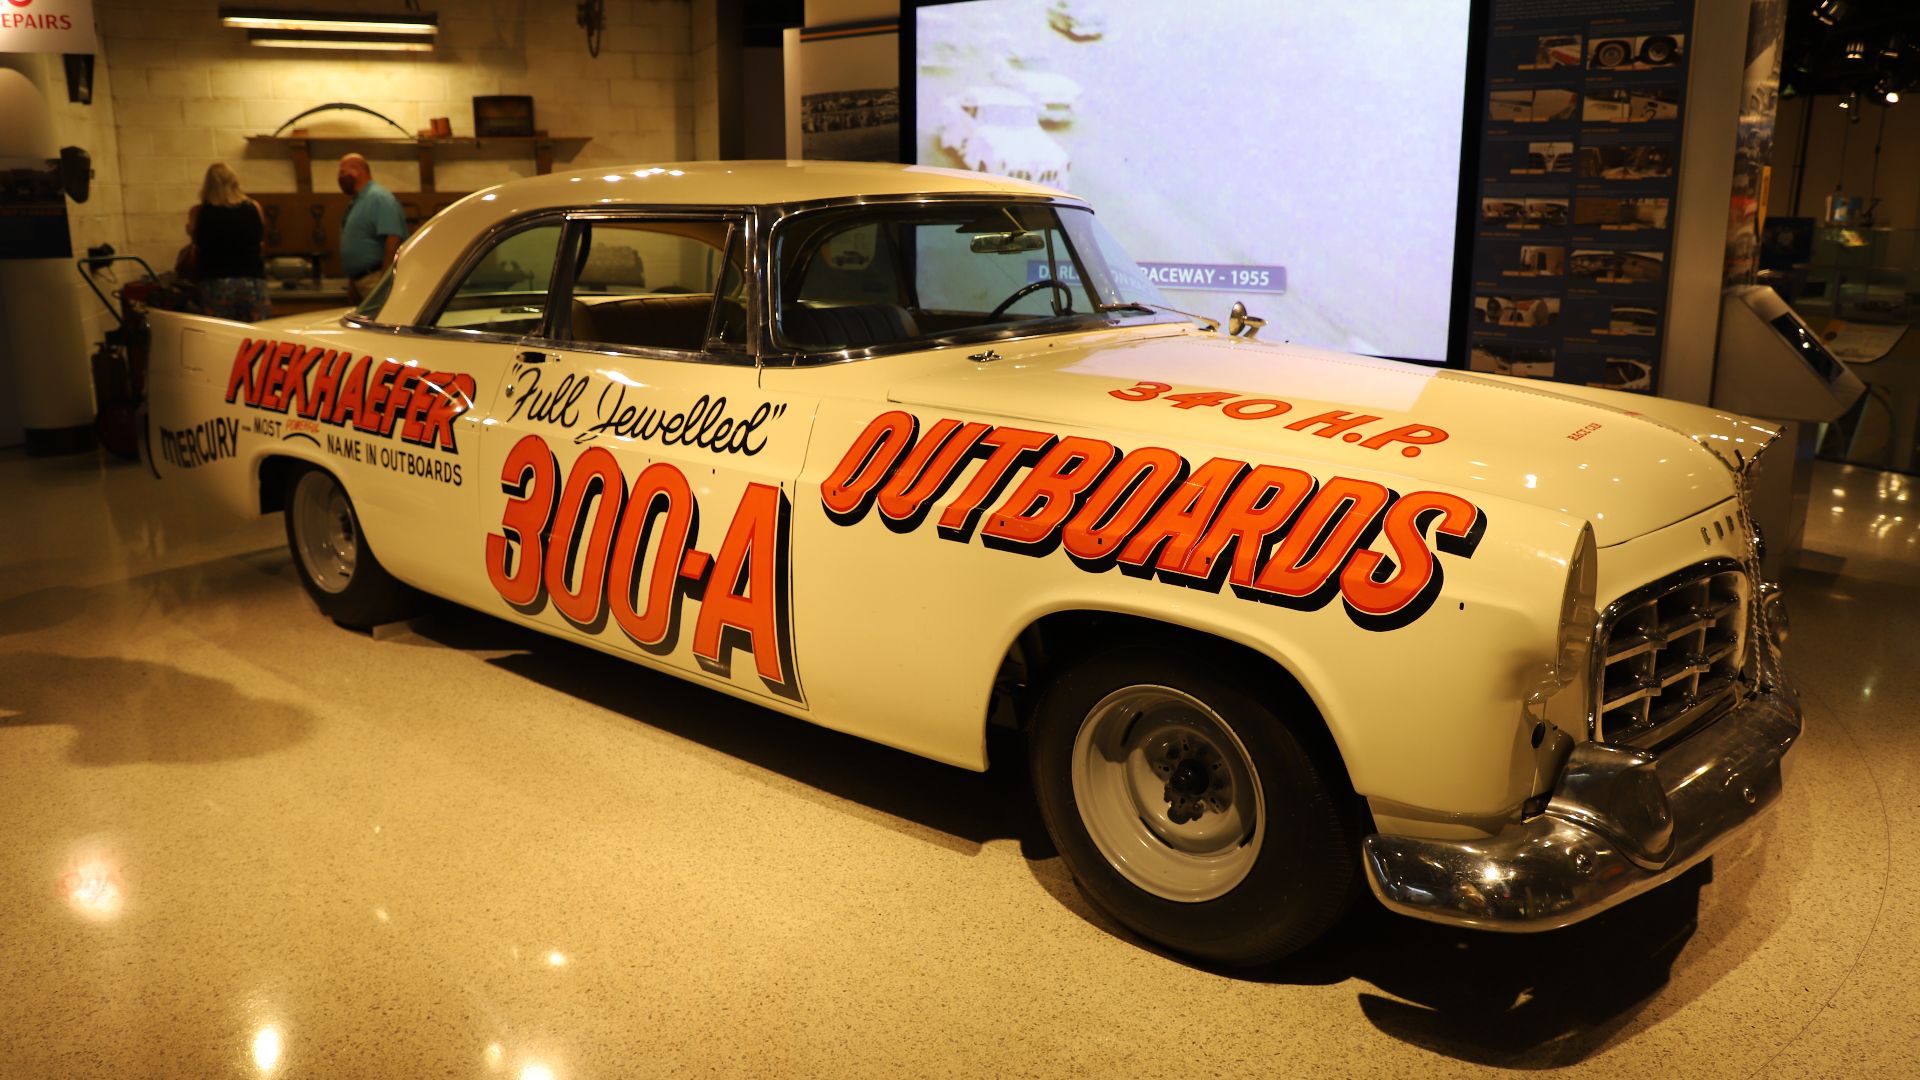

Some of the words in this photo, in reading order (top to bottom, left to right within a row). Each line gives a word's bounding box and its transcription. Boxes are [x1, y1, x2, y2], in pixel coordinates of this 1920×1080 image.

[1230, 269, 1270, 286] 1955
[225, 338, 476, 454] KIEKHAEFER
[1108, 381, 1292, 420] 340
[1283, 410, 1449, 457] H.P.
[160, 417, 239, 469] MERCURY
[254, 416, 282, 439] MOST
[327, 433, 361, 462] NAME
[366, 443, 377, 466] IN
[380, 448, 463, 486] OUTBOARDS
[486, 435, 803, 703] 300-A
[821, 410, 1487, 632] OUTBOARDS
